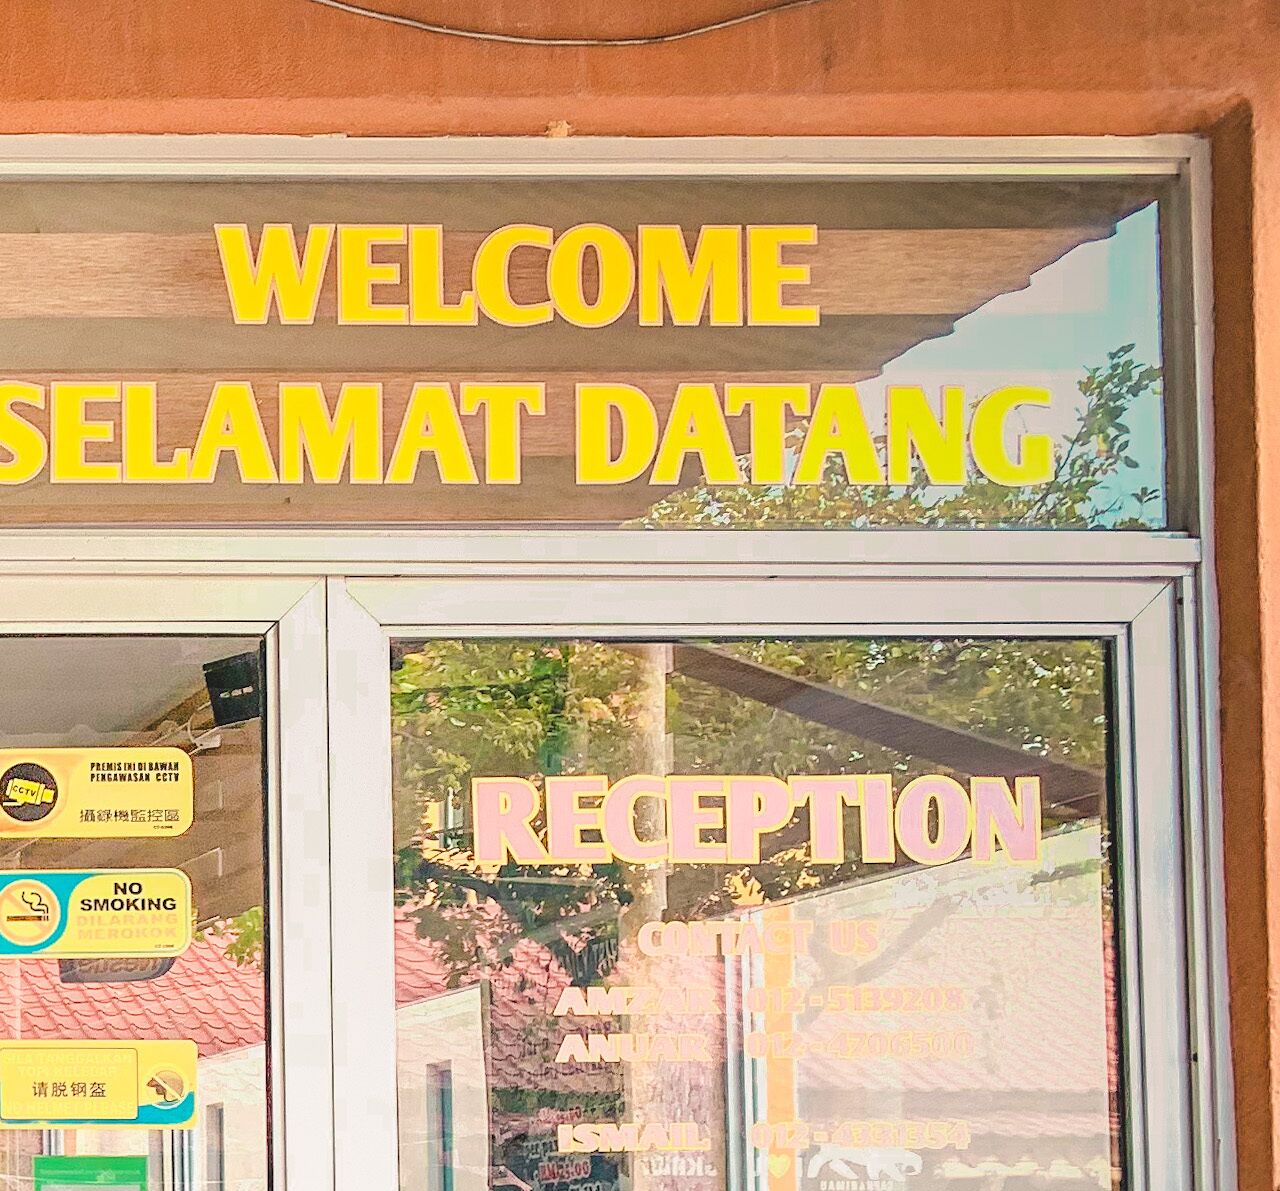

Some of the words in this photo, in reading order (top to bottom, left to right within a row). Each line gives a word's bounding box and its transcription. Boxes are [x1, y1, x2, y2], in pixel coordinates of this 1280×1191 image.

[214, 222, 820, 328] WELCOME
[576, 380, 1053, 487] DATANG
[90, 762, 122, 771] PREMIS
[90, 773, 150, 782] PENGAWASAN
[155, 773, 180, 782] CCTV
[12, 784, 37, 798] CCTV
[471, 774, 1042, 866] RECEPTION
[114, 882, 143, 895] NO
[80, 898, 176, 911] SMOKING
[77, 914, 177, 926] DILARANG
[78, 927, 177, 940] MEROKOK
[638, 920, 815, 955] CONTACT
[829, 919, 880, 954] US
[553, 986, 722, 1016] AMZAR
[555, 1033, 713, 1062] ANUAR
[33, 1081, 107, 1098] 请脱钢盔
[557, 1122, 711, 1152] ISMAIL
